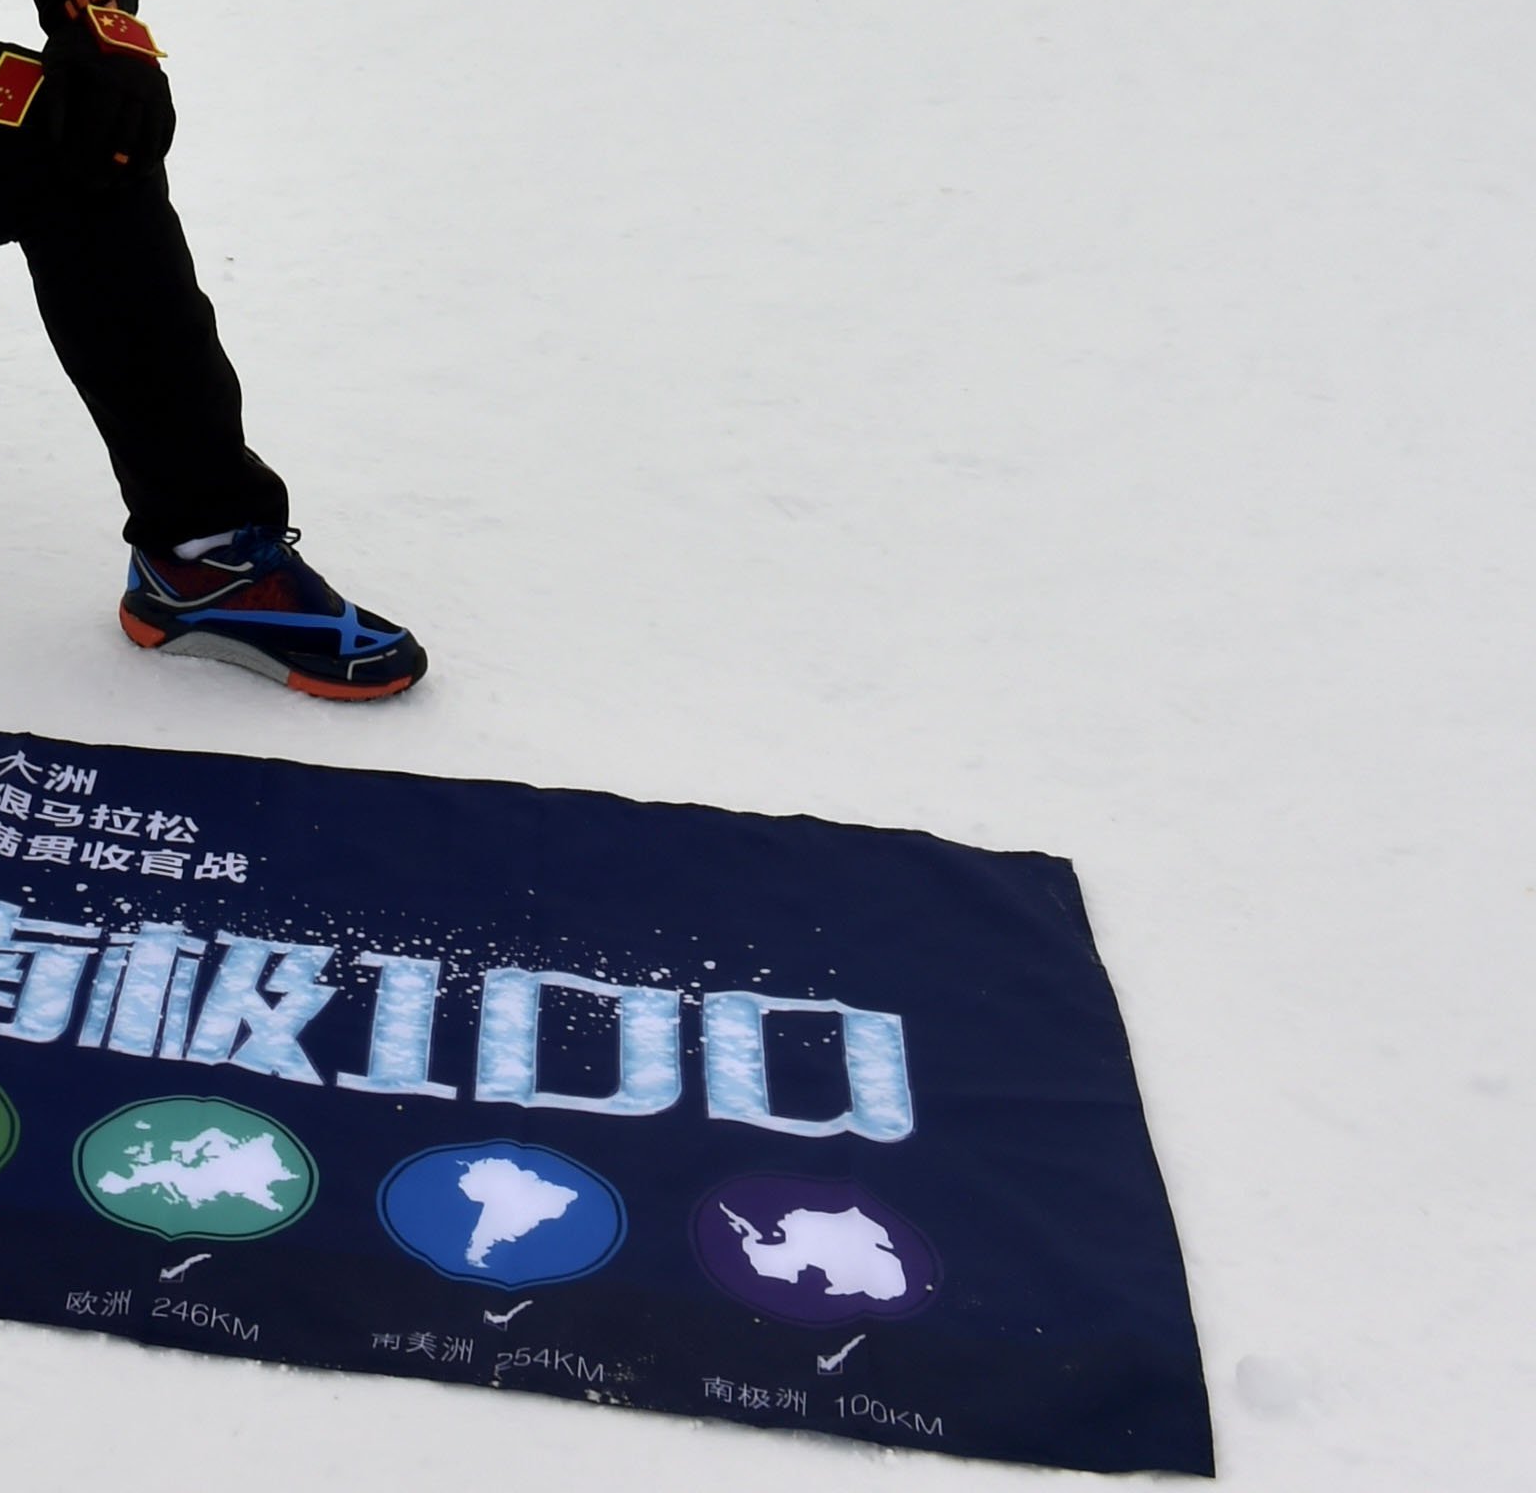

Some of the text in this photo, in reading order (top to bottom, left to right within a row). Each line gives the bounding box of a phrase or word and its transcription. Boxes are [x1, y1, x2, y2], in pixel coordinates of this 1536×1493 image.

[65, 1289, 261, 1343] 欧洲 246KM
[371, 1331, 606, 1384] 南美洲 254KM
[701, 1375, 945, 1438] 南极洲 100KM
